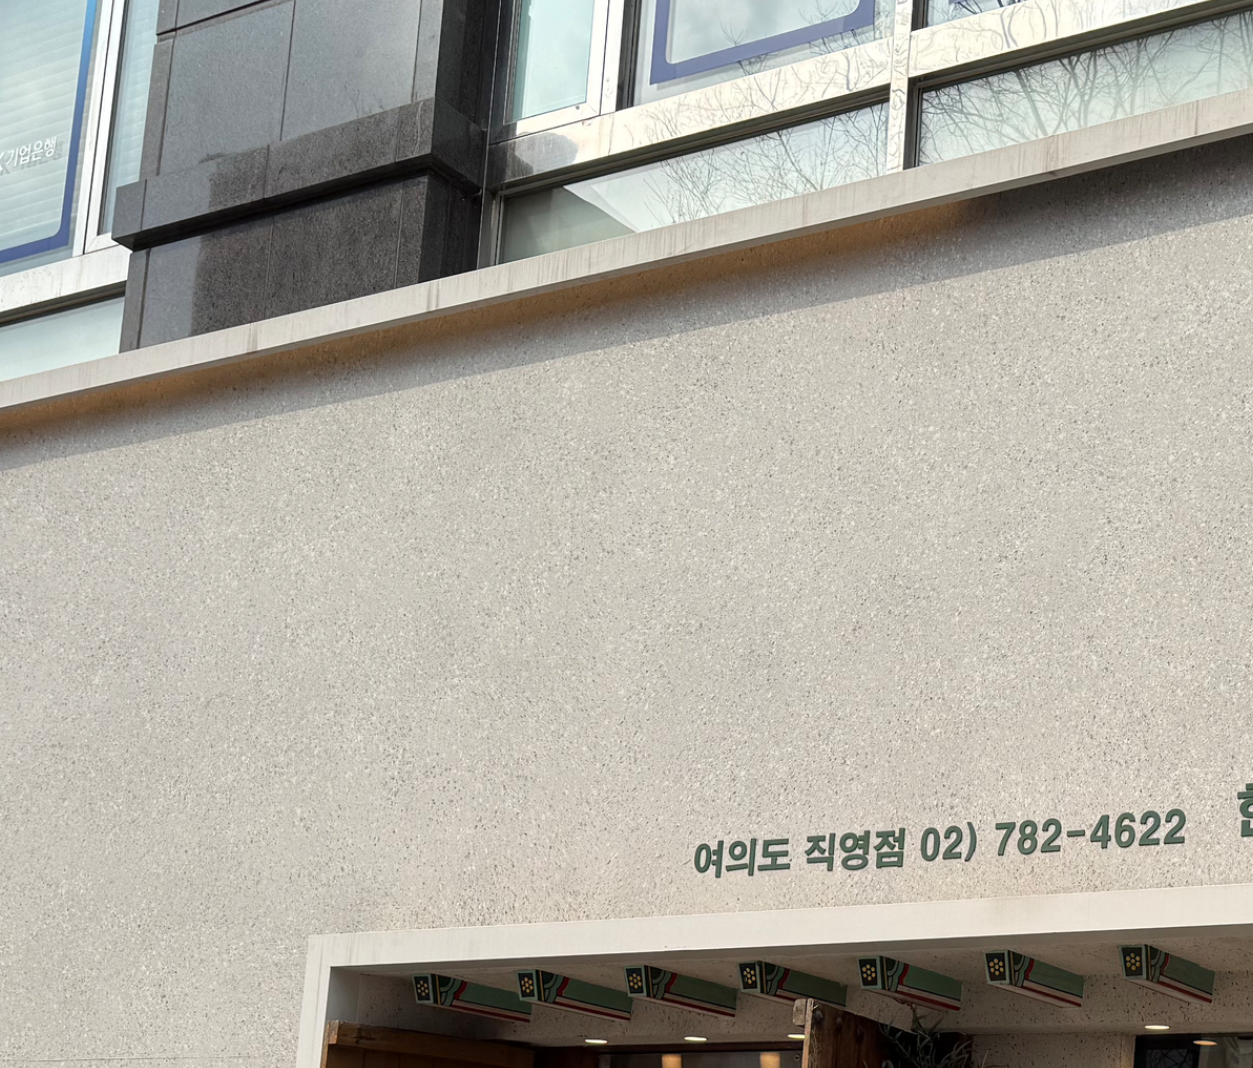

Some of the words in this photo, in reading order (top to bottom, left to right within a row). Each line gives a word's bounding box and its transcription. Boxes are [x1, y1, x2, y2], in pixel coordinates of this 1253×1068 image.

[6, 136, 57, 167] 기업은행
[693, 837, 791, 878] 여의도
[805, 827, 905, 871] 직영점
[919, 821, 978, 863] 02)
[994, 808, 1187, 857] 782-4622
